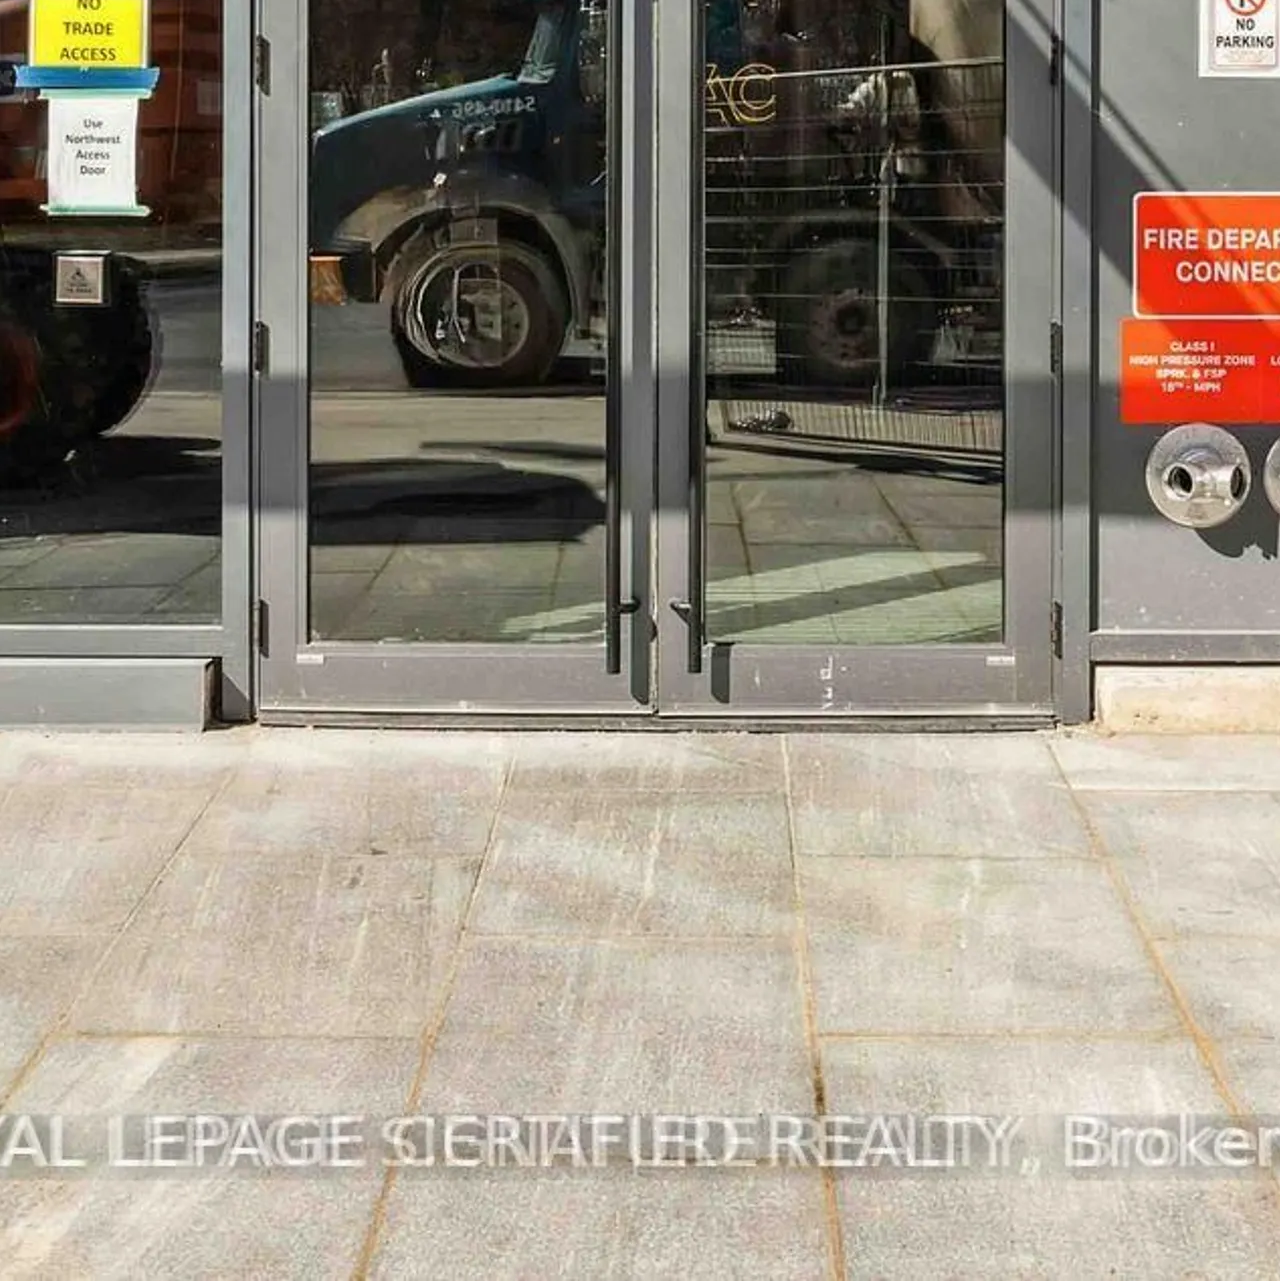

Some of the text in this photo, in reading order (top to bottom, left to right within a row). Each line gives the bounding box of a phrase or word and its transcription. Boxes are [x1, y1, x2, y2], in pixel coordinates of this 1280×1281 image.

[63, 22, 115, 36] TRADE
[1236, 18, 1256, 31] NO
[1216, 36, 1274, 48] PARKING
[60, 47, 117, 61] ACCESS
[83, 118, 103, 129] Use
[65, 134, 121, 144] Northwest
[76, 150, 110, 160] Access
[80, 165, 106, 175] Door
[1143, 228, 1199, 249] FIRE
[1170, 341, 1208, 352] CLASS
[1129, 355, 1256, 366] HIGH PRESSURE ZONE
